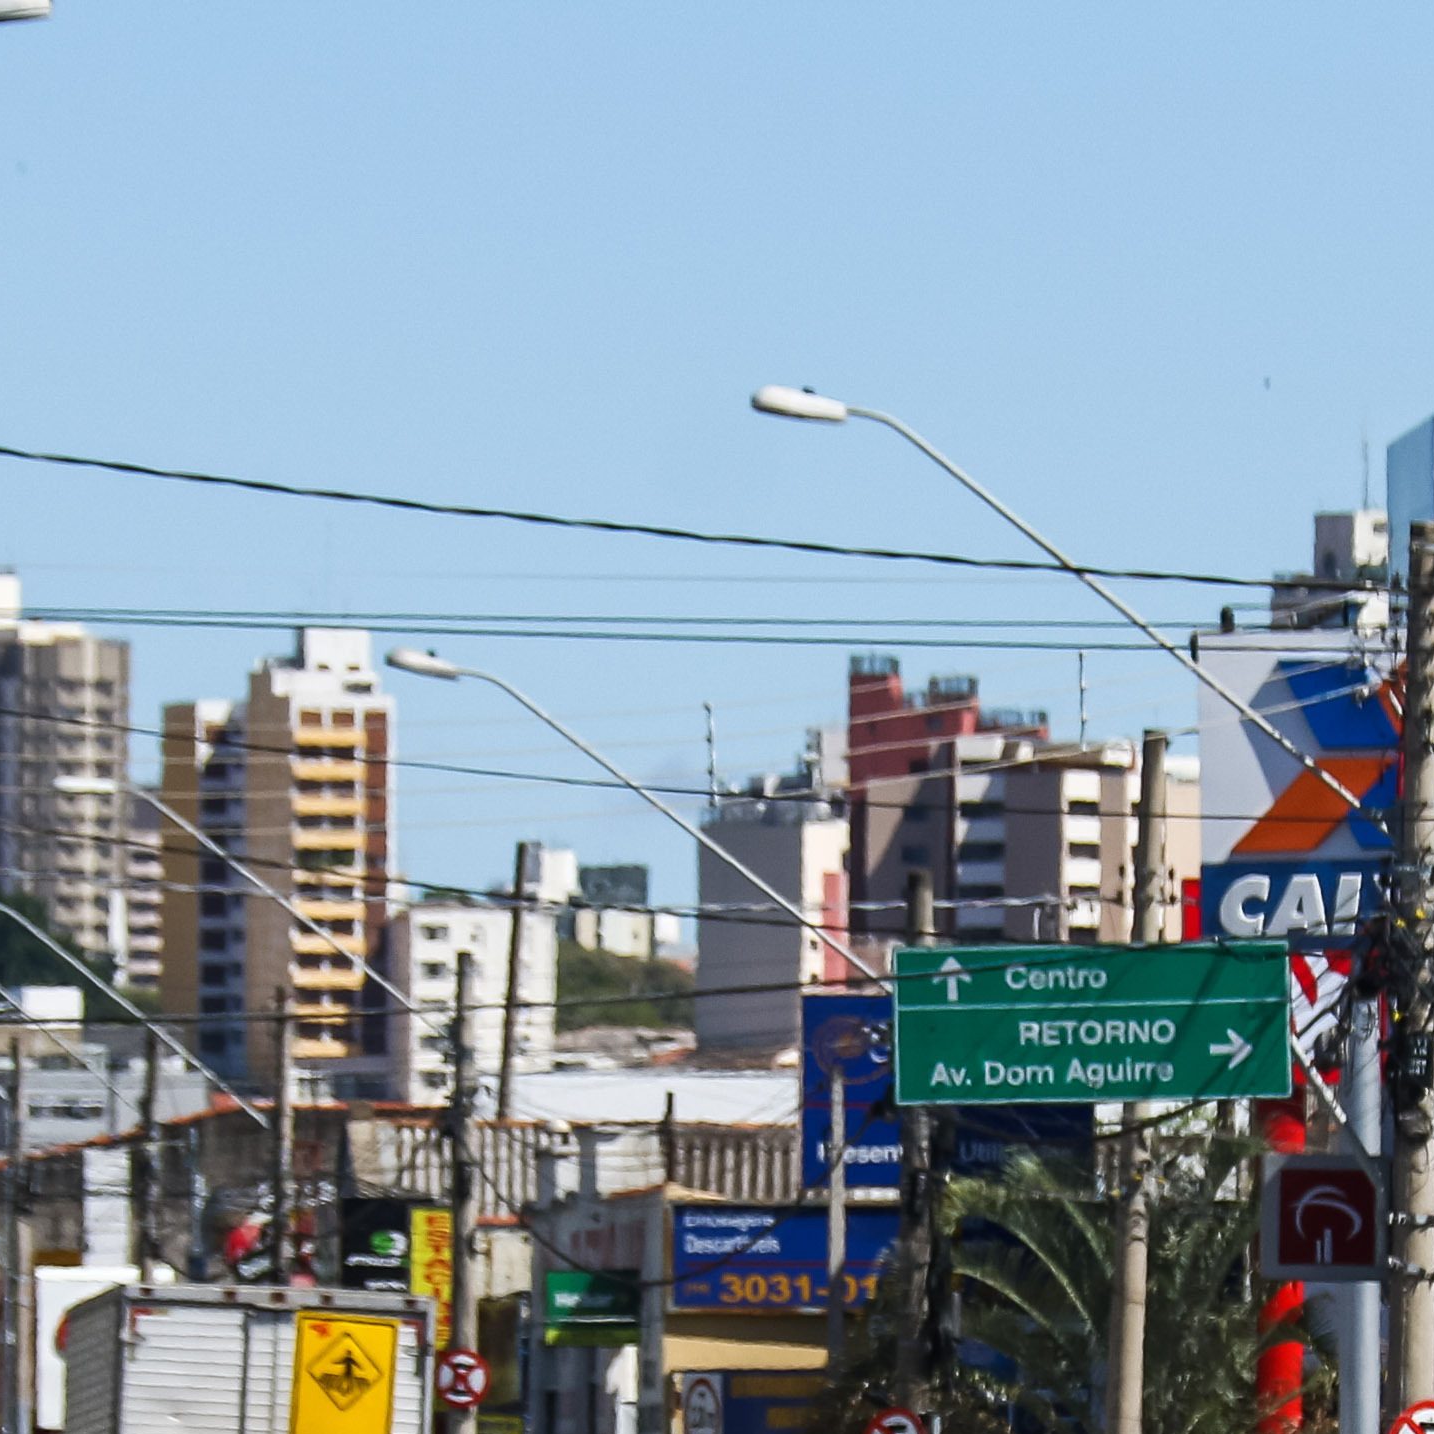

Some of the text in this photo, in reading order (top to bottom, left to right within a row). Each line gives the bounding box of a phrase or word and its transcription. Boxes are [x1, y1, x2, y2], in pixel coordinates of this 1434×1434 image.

[1004, 964, 1108, 991] Centro
[1018, 1019, 1178, 1047] RETORNO
[930, 1058, 1175, 1090] Av. Dom Aguirre
